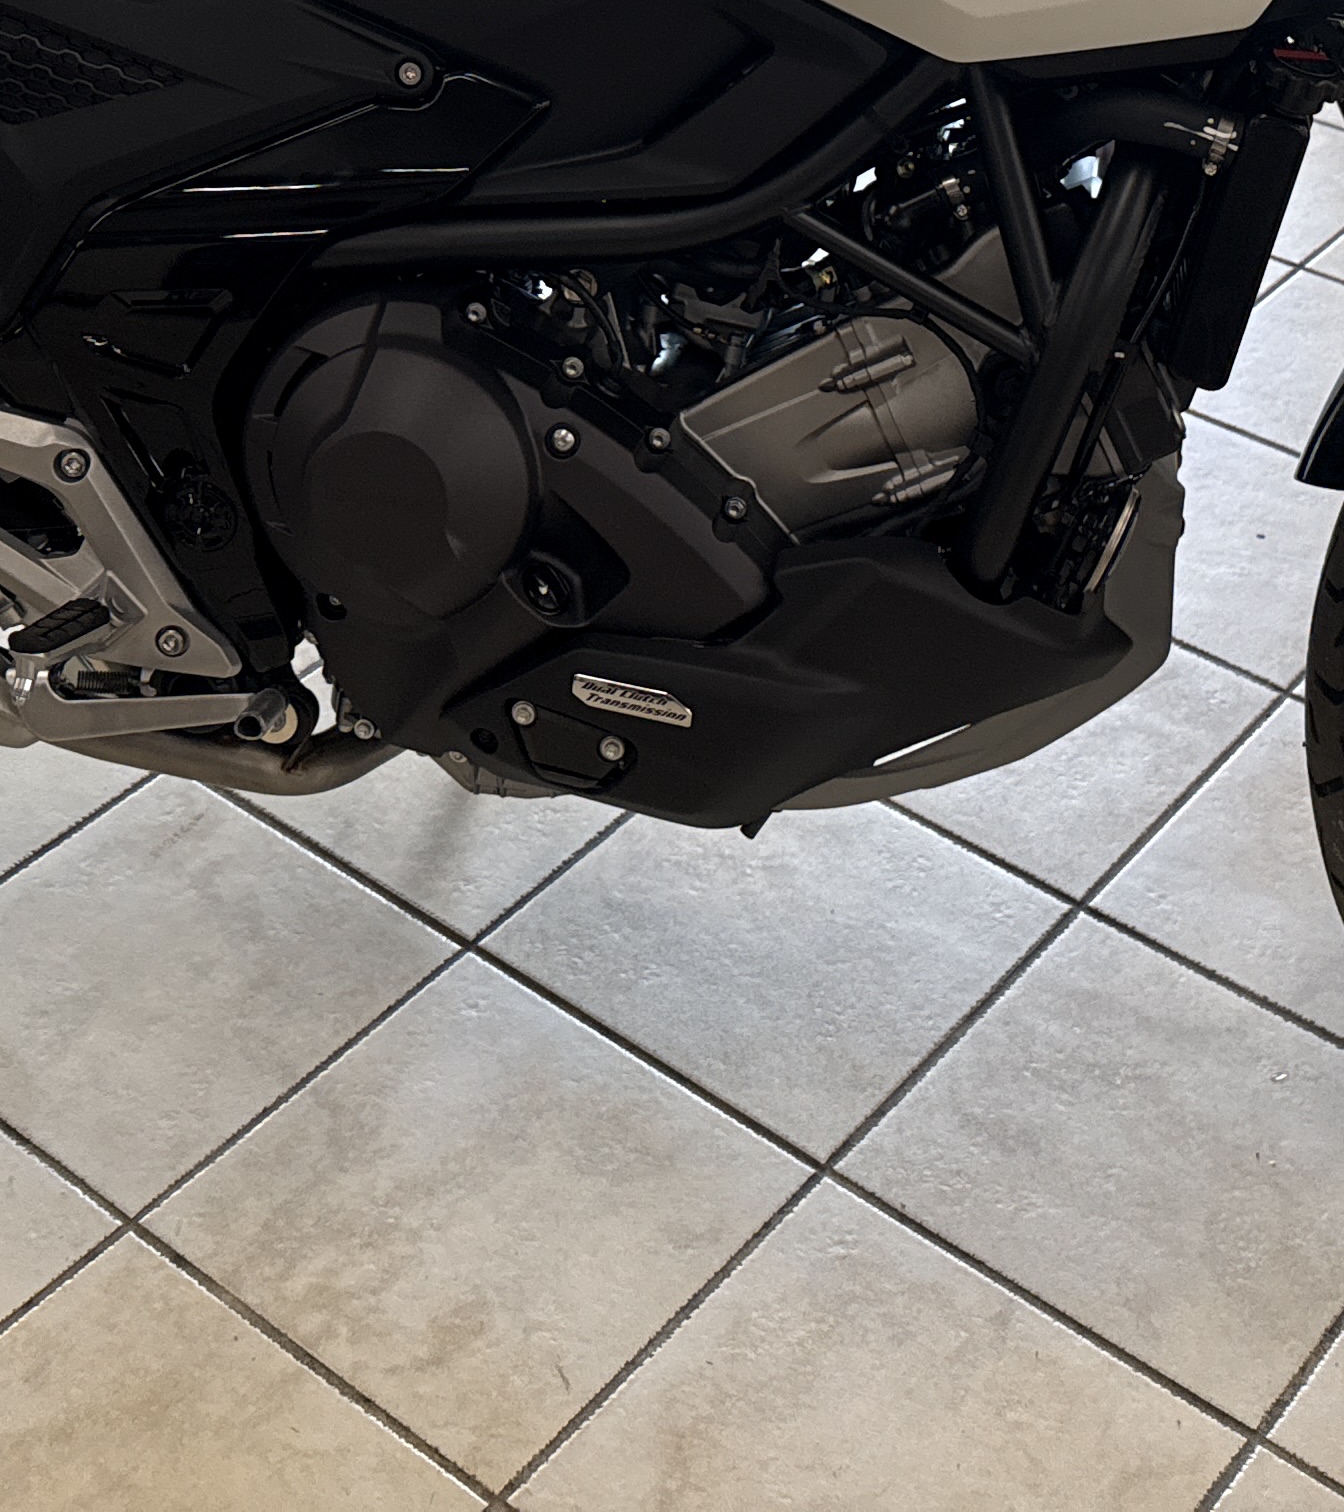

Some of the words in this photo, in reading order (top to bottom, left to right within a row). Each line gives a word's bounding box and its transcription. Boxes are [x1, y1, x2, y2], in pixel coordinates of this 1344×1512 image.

[581, 681, 618, 695] Dual
[619, 688, 668, 706] Clutch
[586, 692, 687, 721] Transmission
